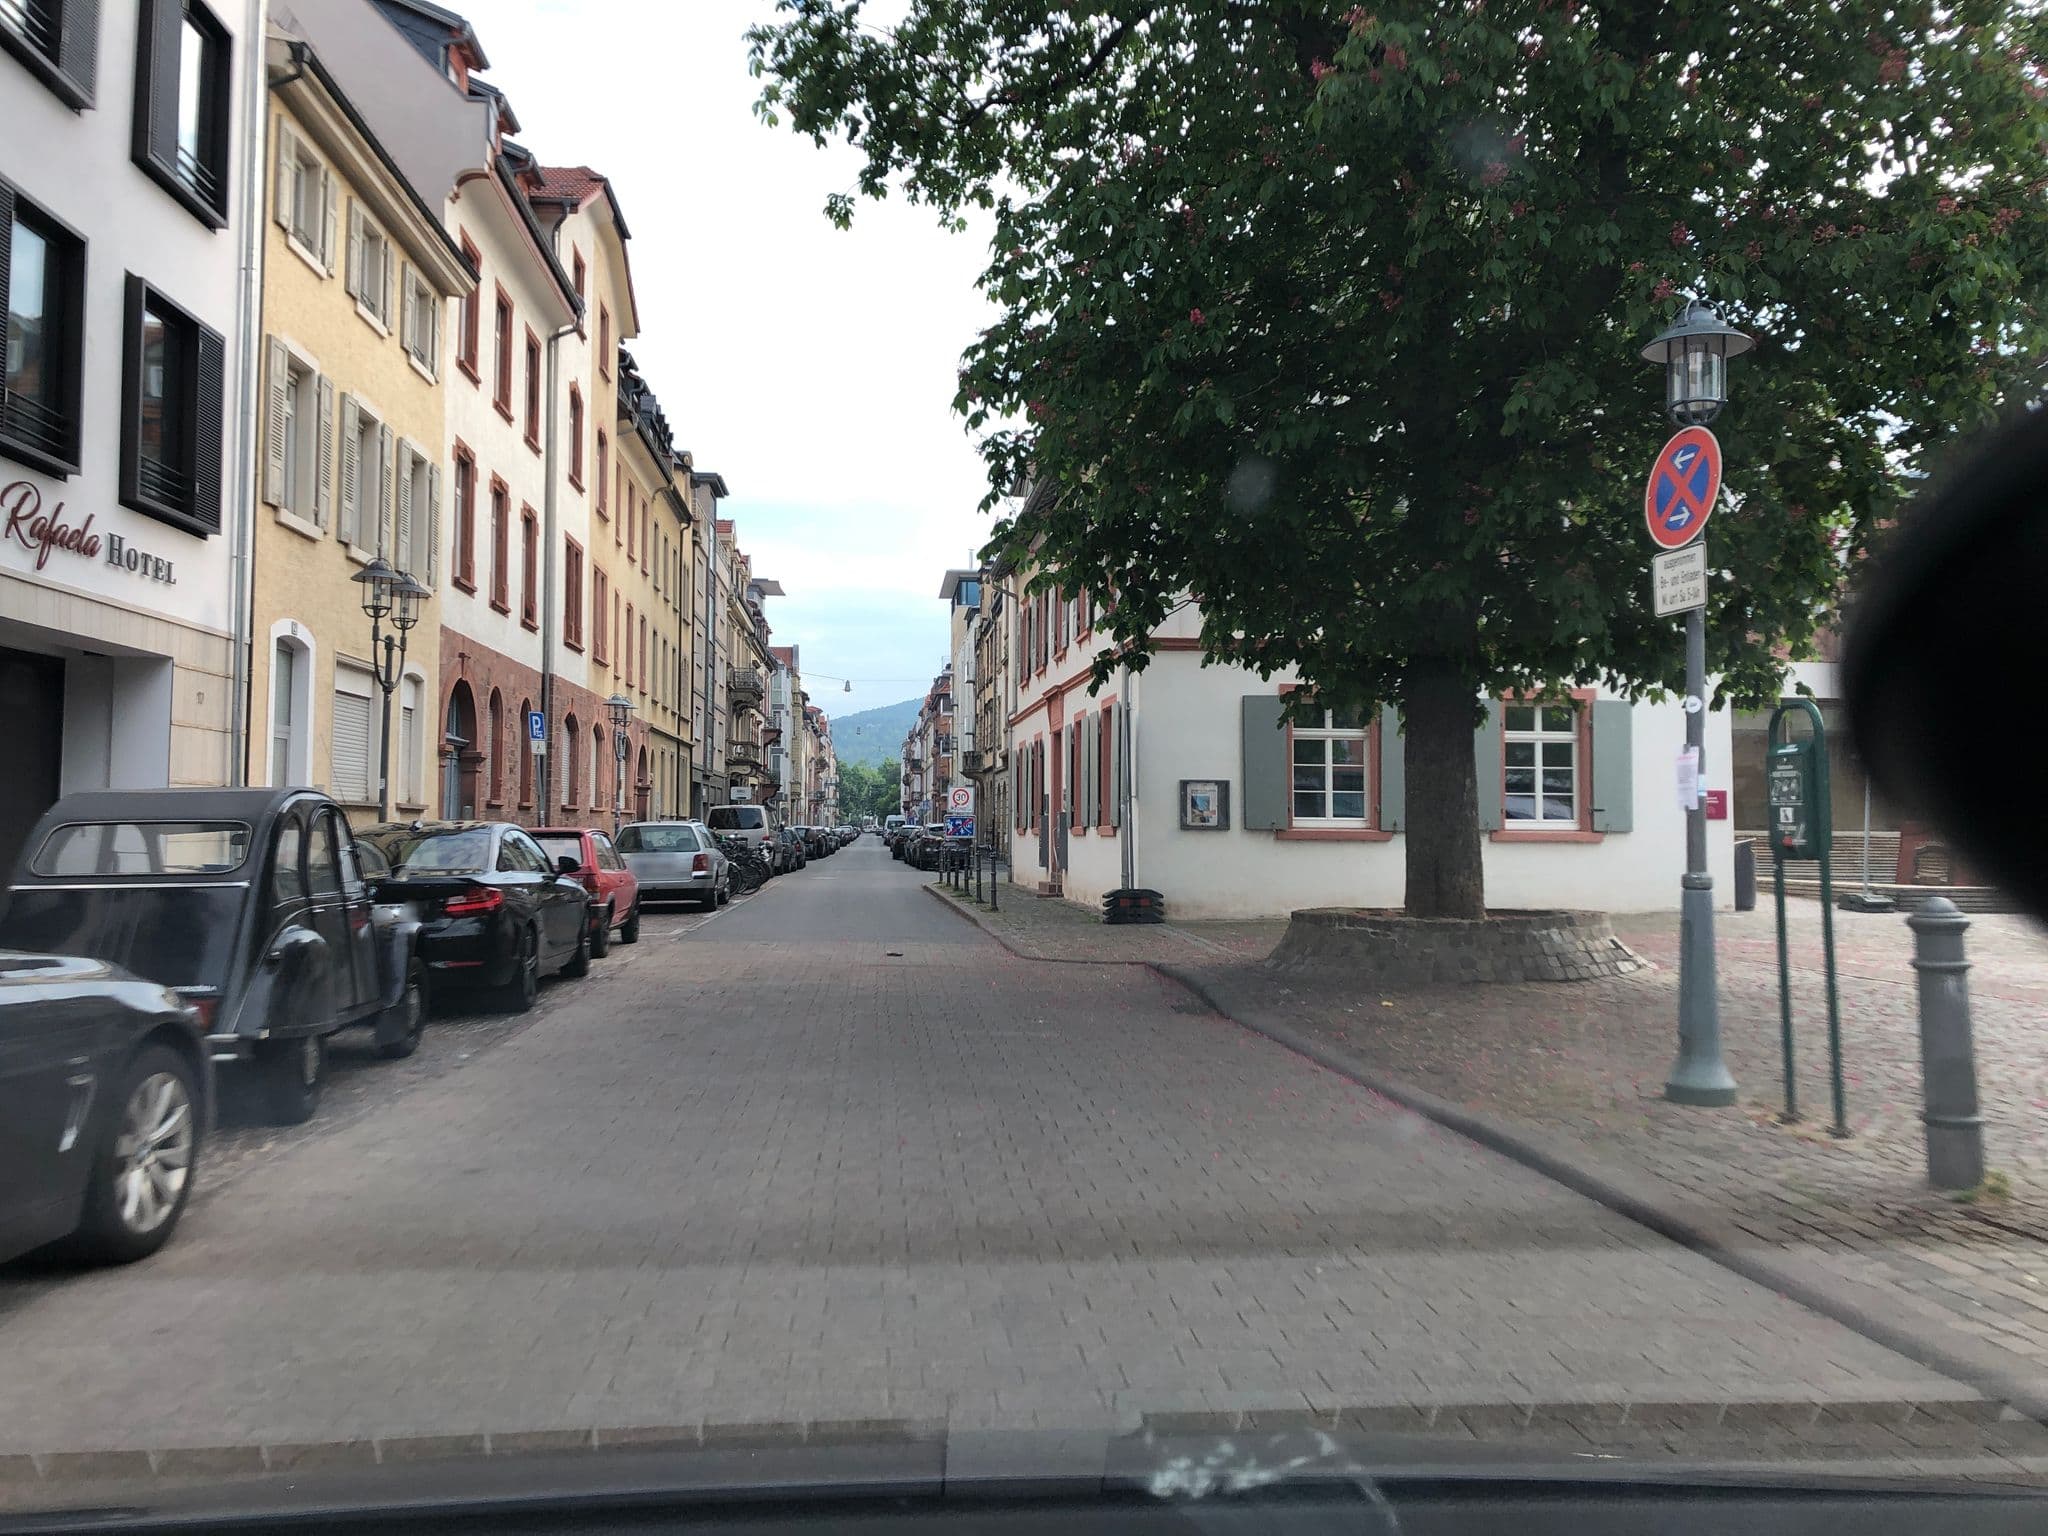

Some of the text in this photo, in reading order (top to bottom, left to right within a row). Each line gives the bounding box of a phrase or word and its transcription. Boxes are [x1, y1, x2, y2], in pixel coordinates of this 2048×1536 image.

[0, 481, 101, 570] Rafaela
[532, 715, 541, 736] P
[955, 793, 967, 801] 30
